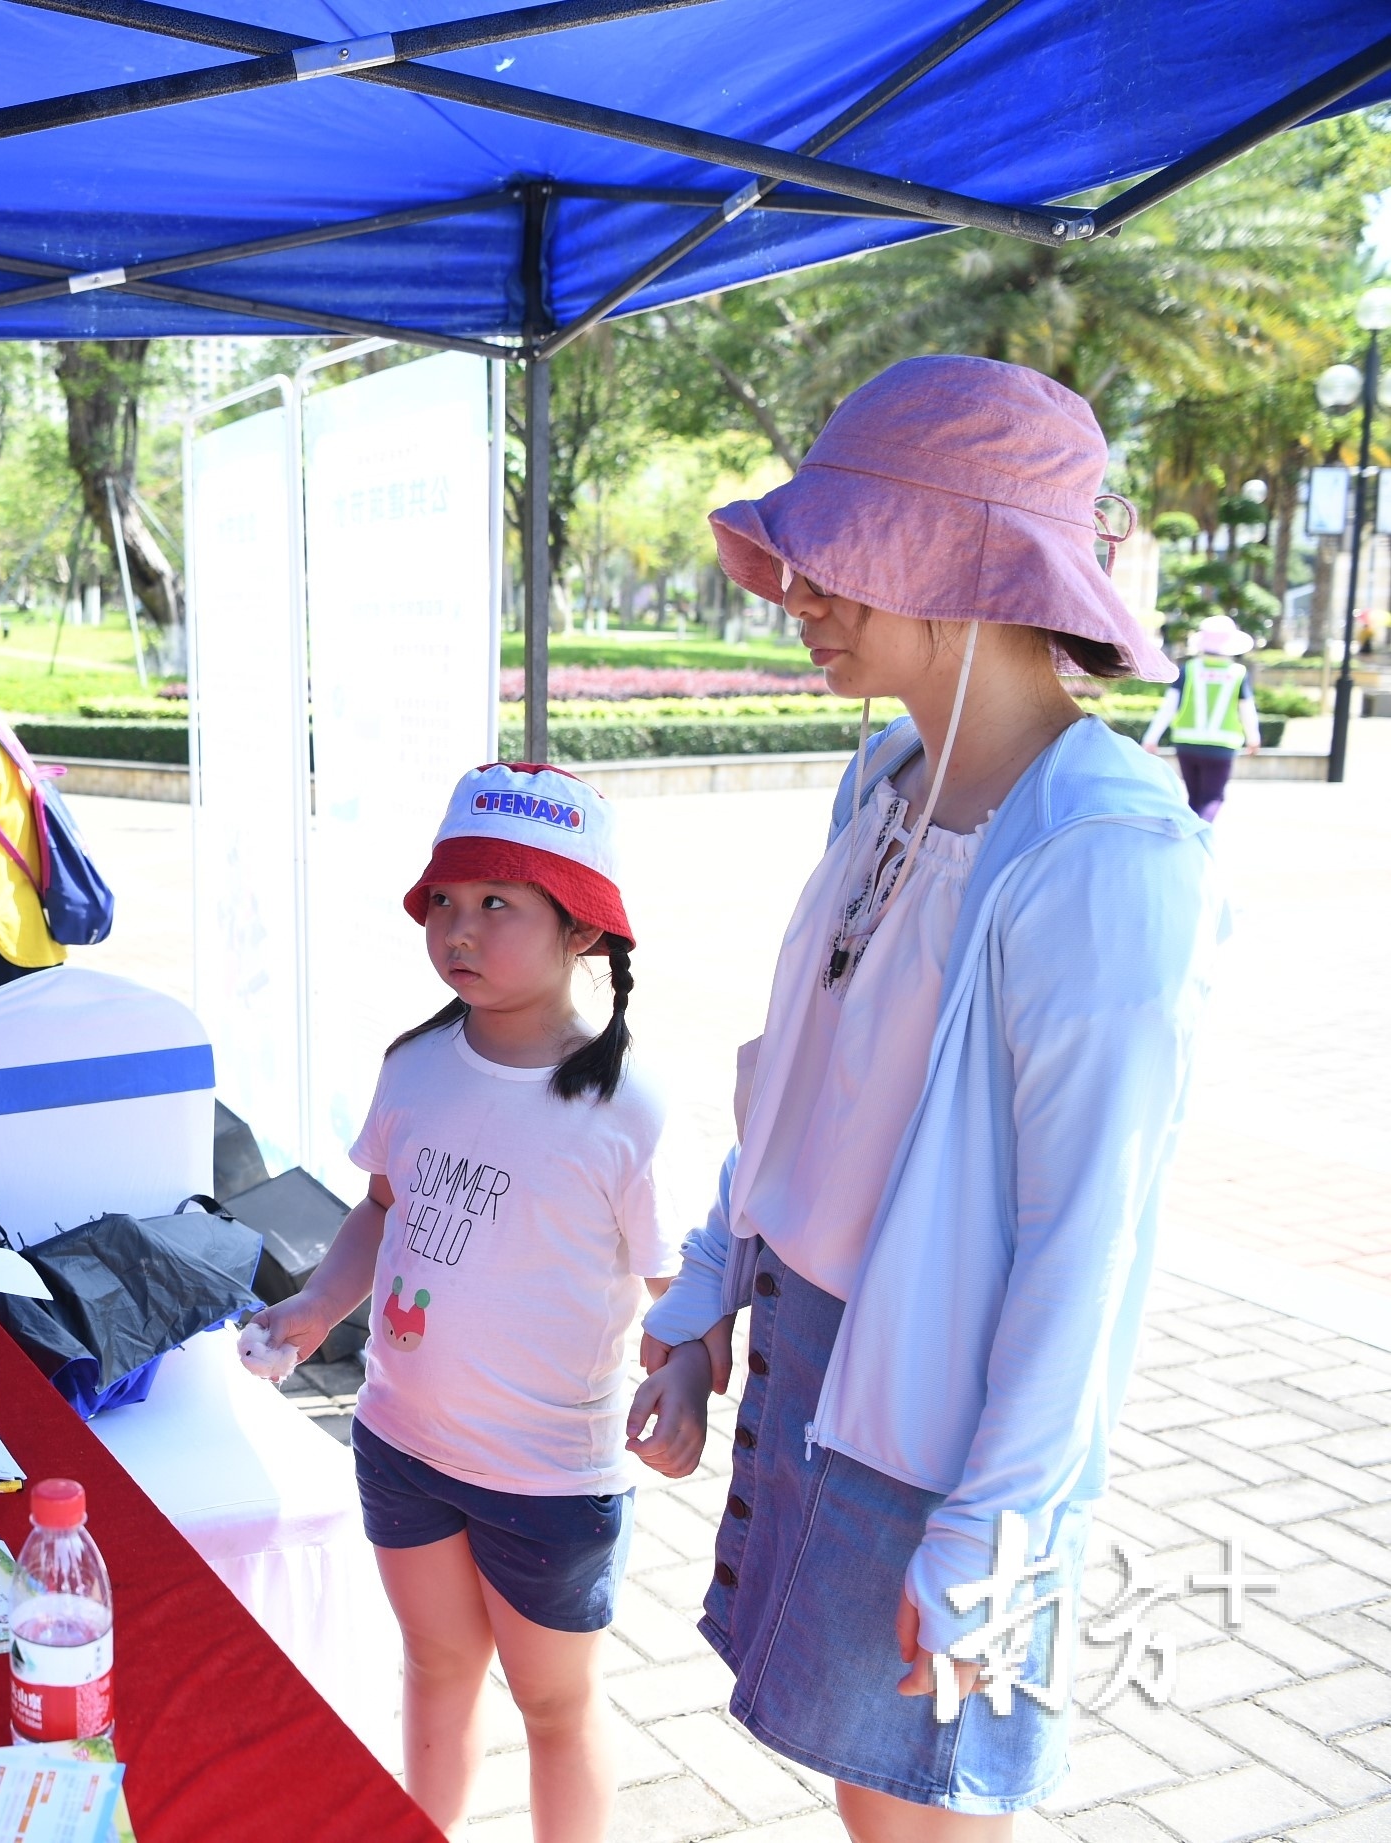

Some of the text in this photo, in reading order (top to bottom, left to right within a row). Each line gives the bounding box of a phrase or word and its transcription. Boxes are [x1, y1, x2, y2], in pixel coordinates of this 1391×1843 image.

[483, 792, 574, 829] TENAX
[409, 1147, 511, 1221] SUMMER
[402, 1200, 473, 1266] HELLO
